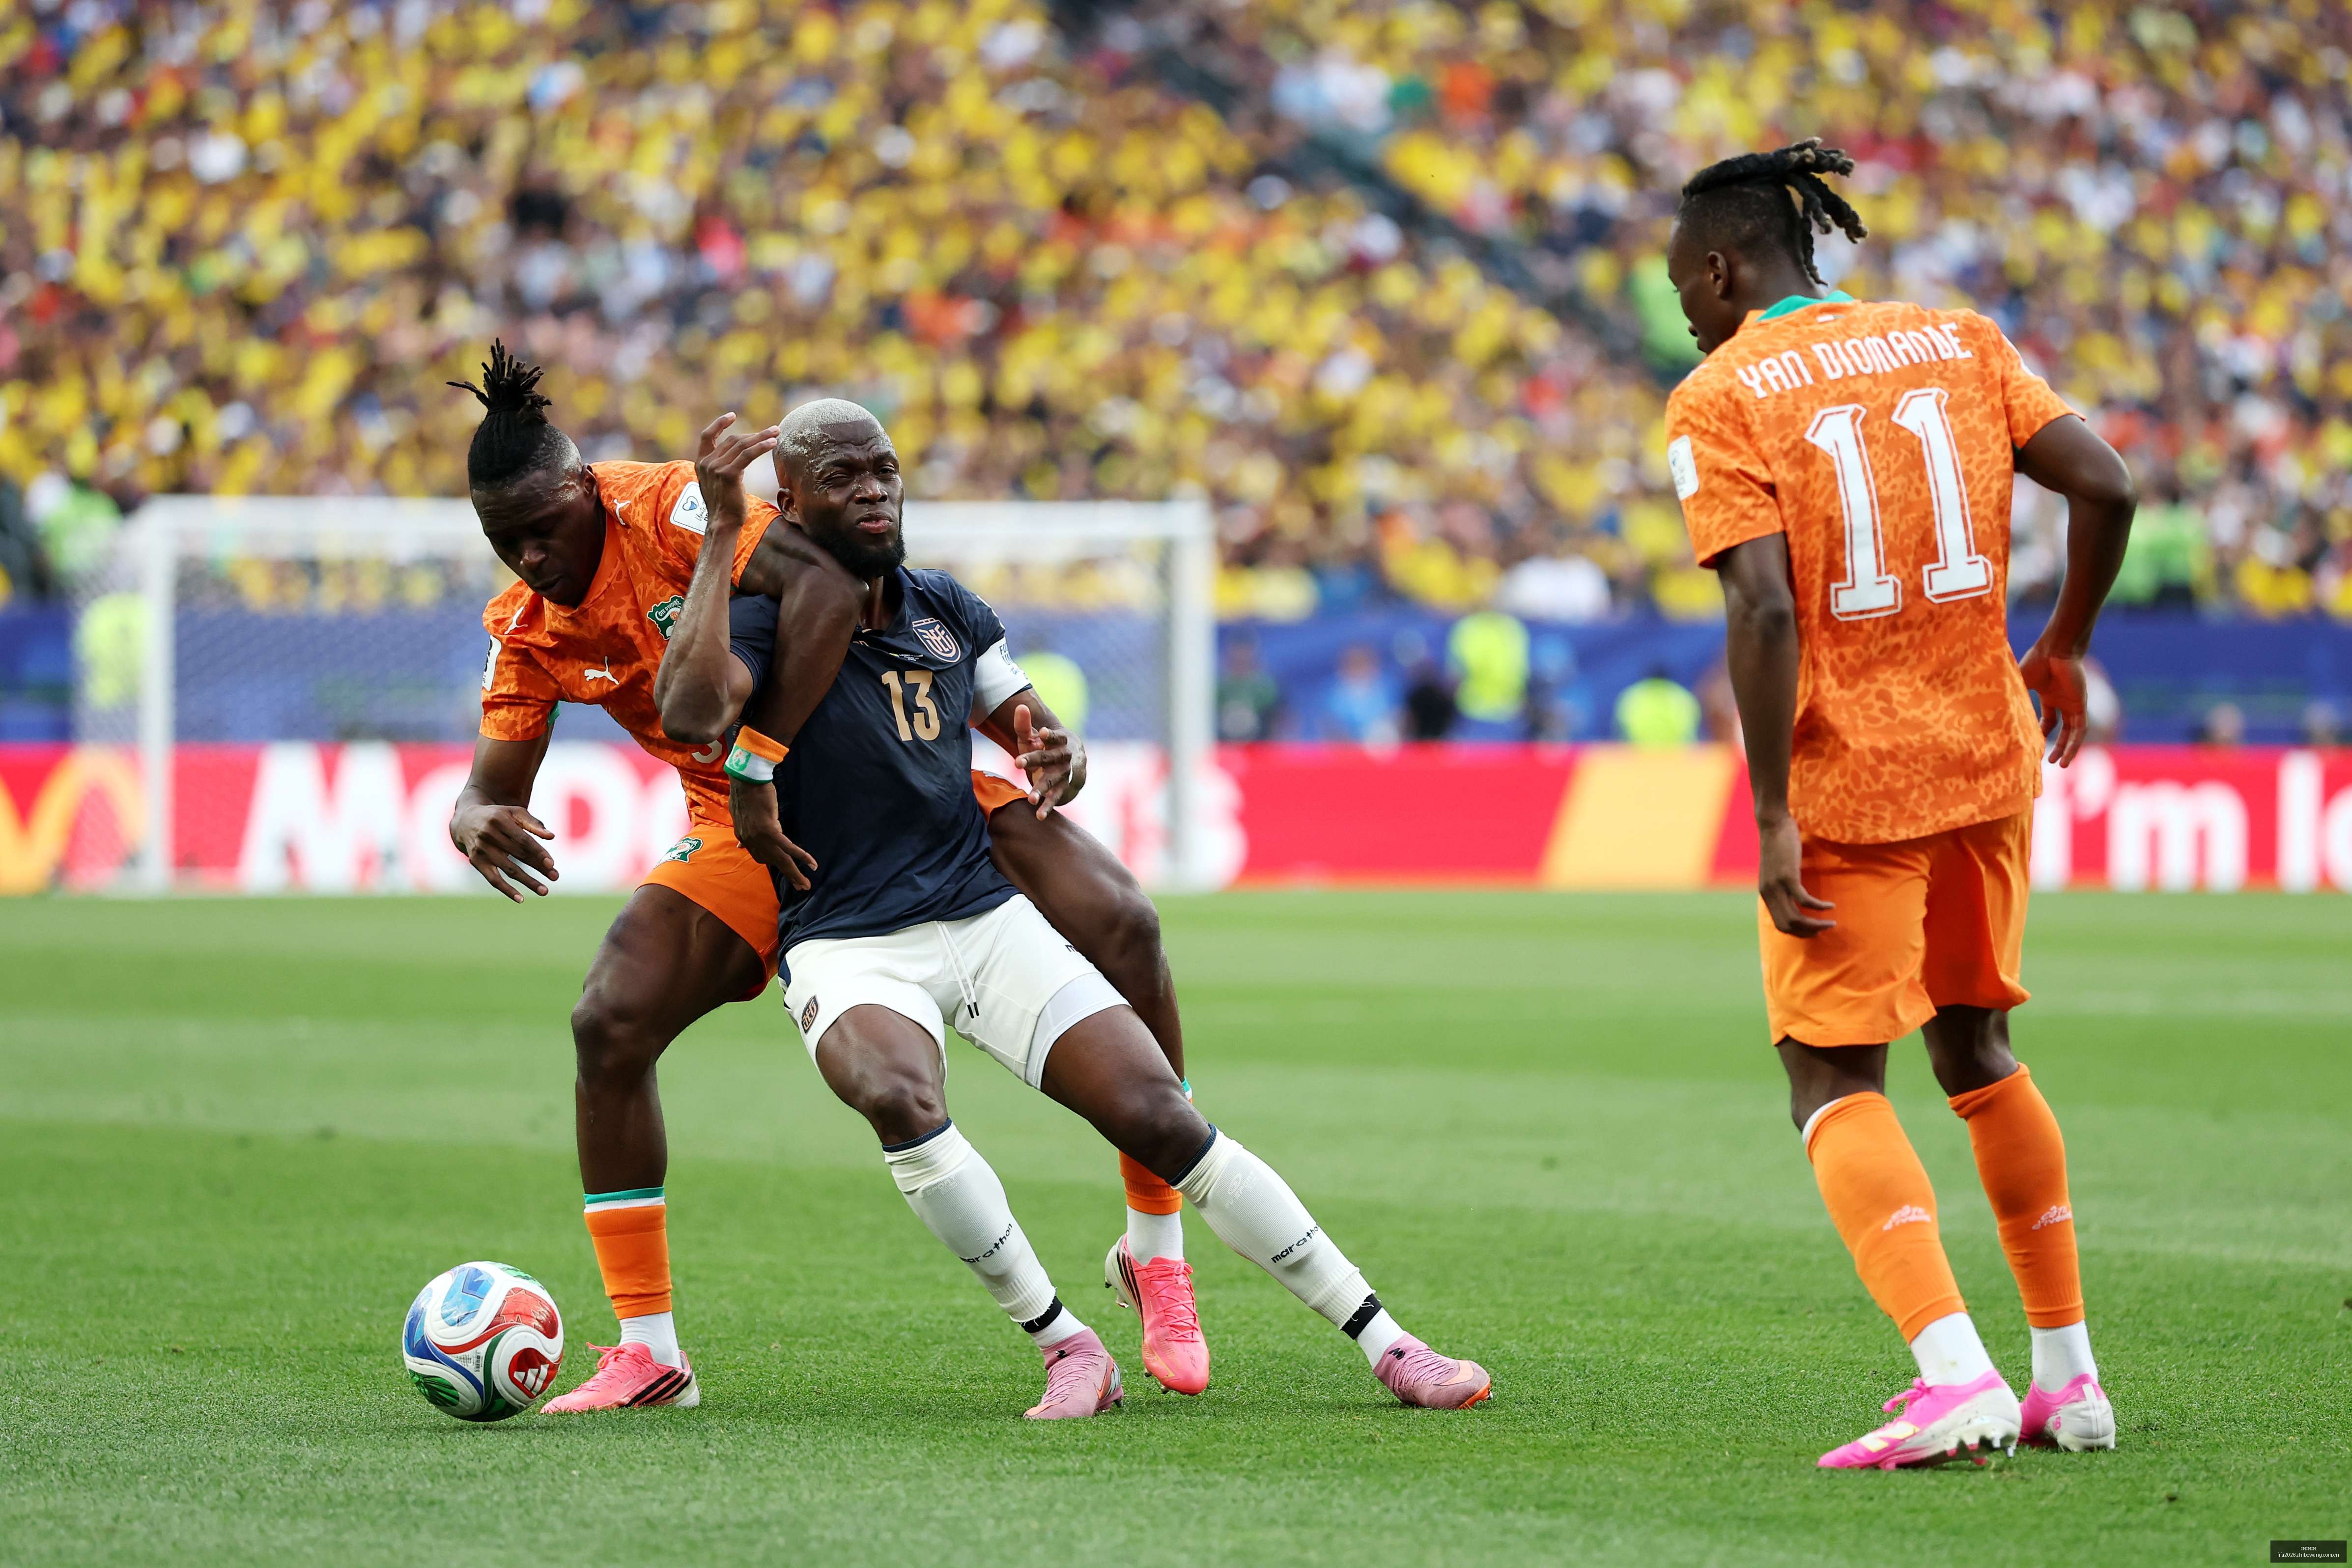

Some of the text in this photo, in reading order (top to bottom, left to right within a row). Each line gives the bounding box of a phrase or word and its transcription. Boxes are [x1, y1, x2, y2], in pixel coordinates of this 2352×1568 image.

[1736, 322, 1973, 399] YAN DIOMANDE
[1804, 387, 1993, 622] 11
[881, 670, 940, 741] 13
